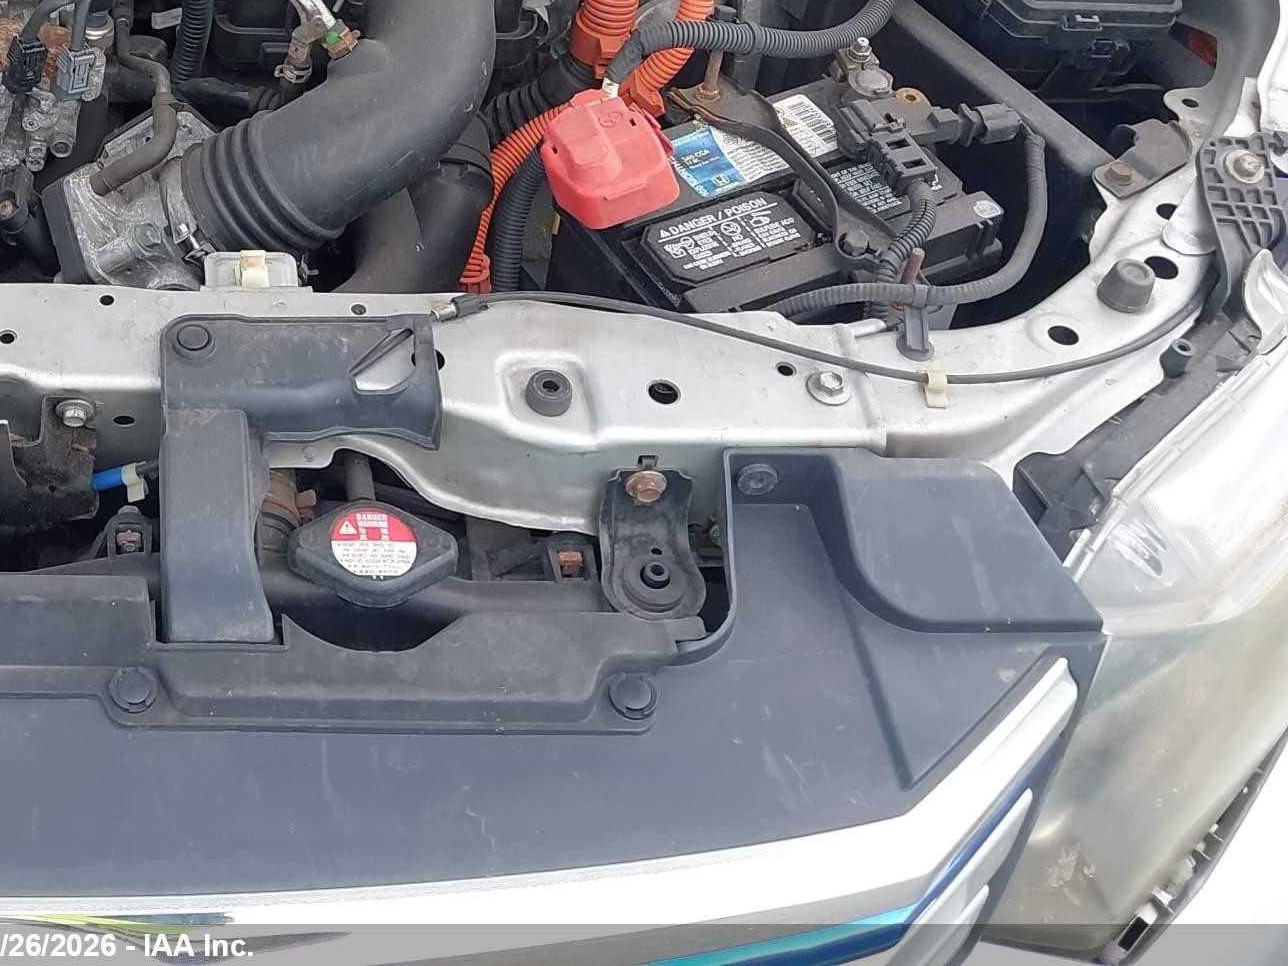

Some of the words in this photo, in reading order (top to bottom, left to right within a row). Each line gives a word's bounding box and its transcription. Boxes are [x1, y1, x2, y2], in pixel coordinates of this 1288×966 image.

[669, 214, 717, 235] DANGER
[724, 197, 767, 217] POISON
[732, 234, 743, 242] NO
[356, 513, 388, 521] DANGER
